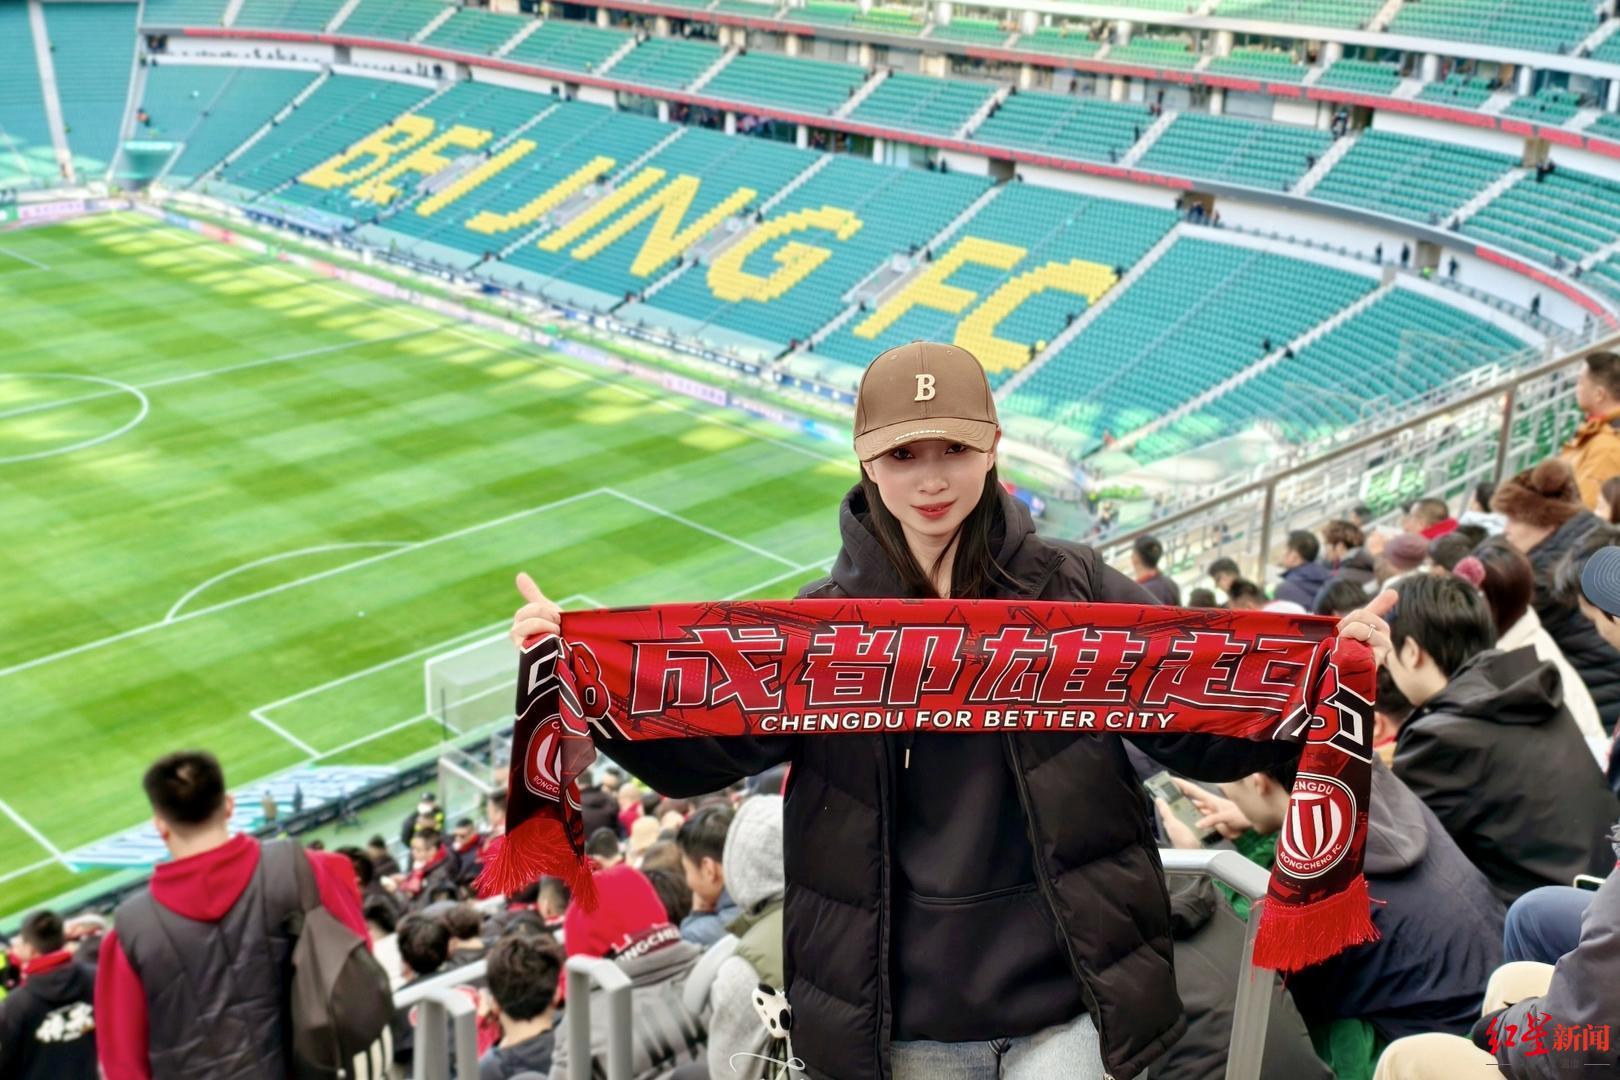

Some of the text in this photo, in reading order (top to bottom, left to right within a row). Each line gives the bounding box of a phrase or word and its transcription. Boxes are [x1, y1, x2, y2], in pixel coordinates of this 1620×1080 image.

[297, 114, 1118, 374] BEIJING FC
[914, 373, 936, 401] B
[630, 623, 1318, 718] 成都雄起
[760, 710, 1177, 732] CHENGDU FOR BETTER CITY
[533, 775, 560, 794] RONGC
[1292, 780, 1334, 796] ENGDU
[1279, 843, 1342, 870] RONGCHENG FC
